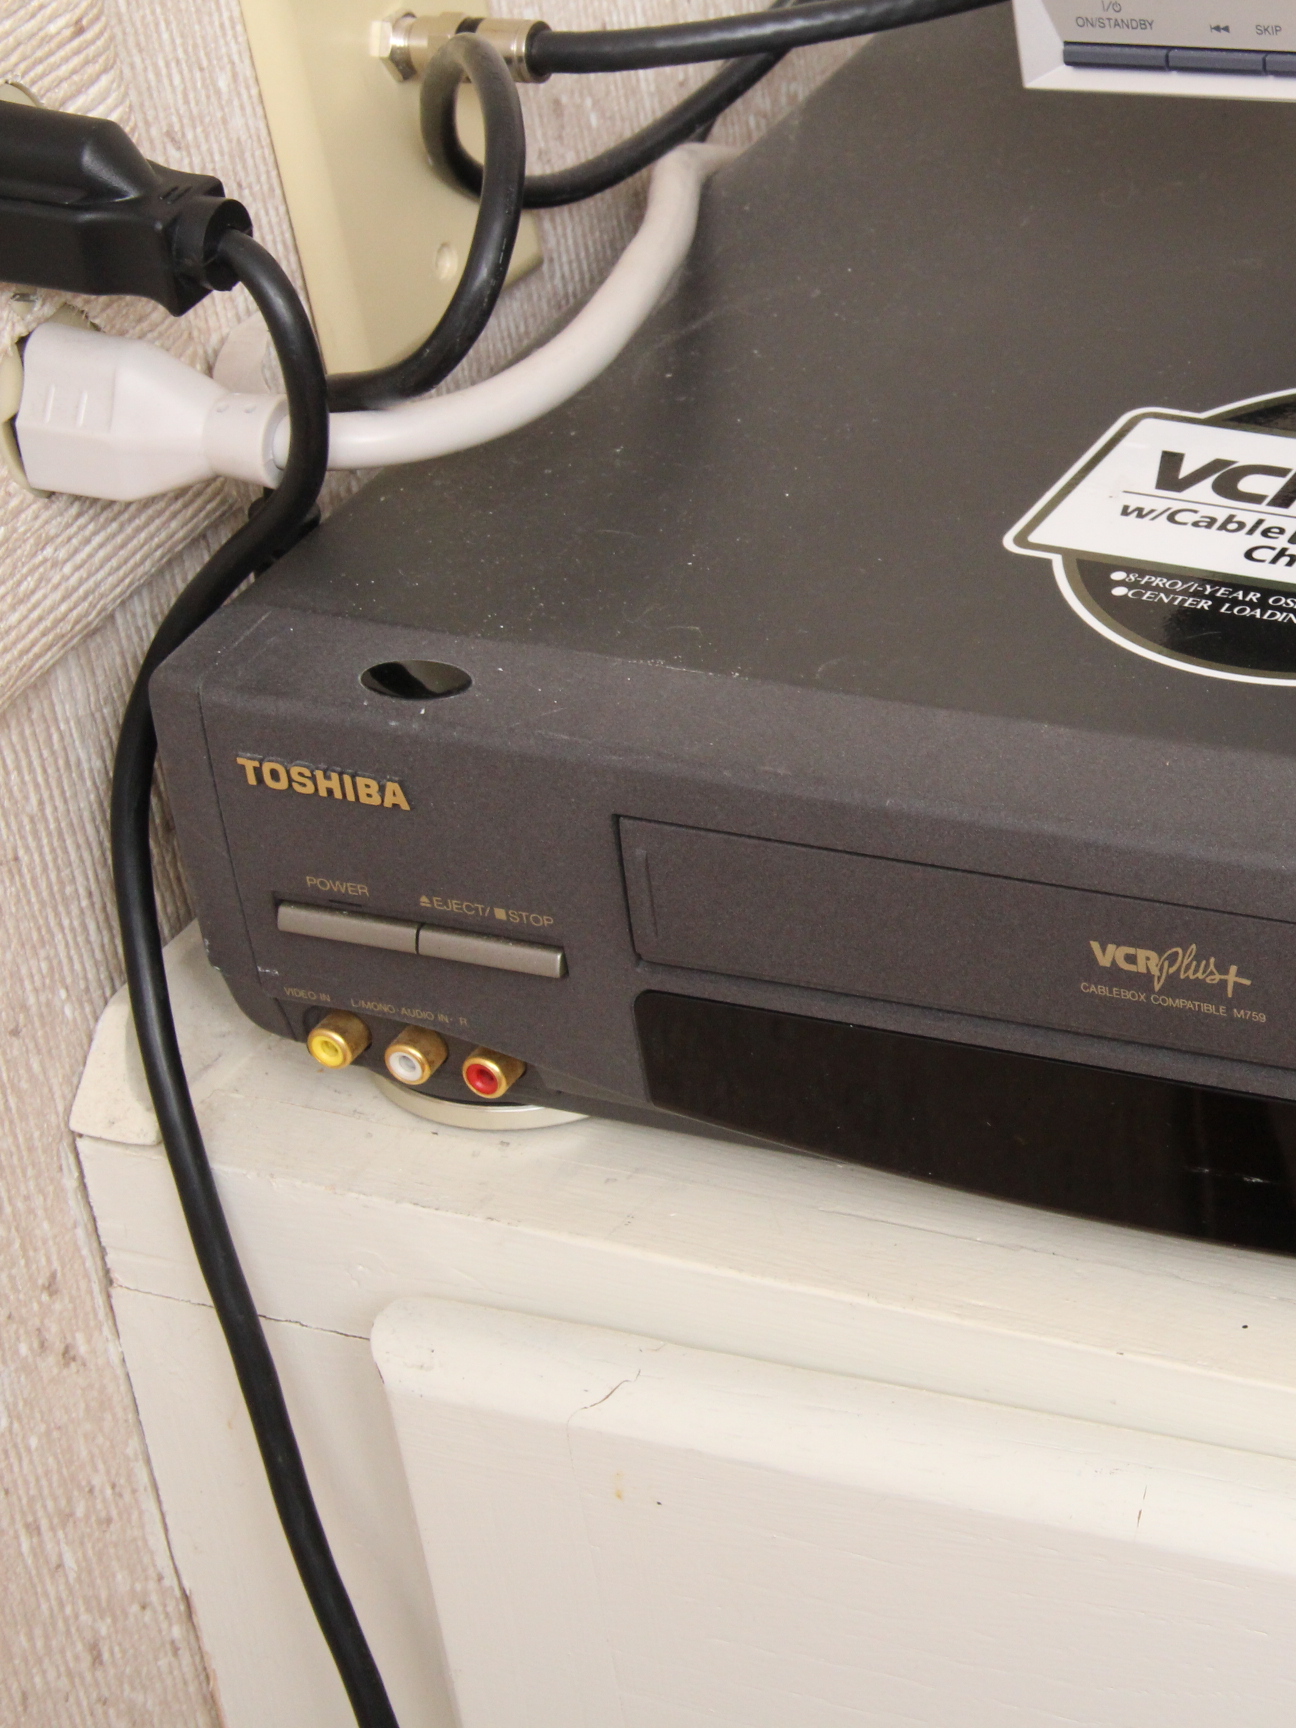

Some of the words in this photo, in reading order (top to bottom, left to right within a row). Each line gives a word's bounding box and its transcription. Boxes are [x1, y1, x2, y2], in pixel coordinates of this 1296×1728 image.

[1075, 16, 1154, 31] ON/STANDBY
[1255, 24, 1282, 36] SKIP
[1119, 504, 1286, 540] w/Cable
[1127, 588, 1212, 611] CENTER
[236, 756, 411, 811] TOSHIBA
[305, 876, 369, 896] POWER
[509, 911, 554, 927] STOP
[284, 986, 317, 1001] VIDEO
[319, 993, 331, 1002] IN
[1080, 982, 1146, 1003] CABLEBOX
[1150, 995, 1227, 1016] COMPATIBLE
[401, 1007, 434, 1022] AUDIO
